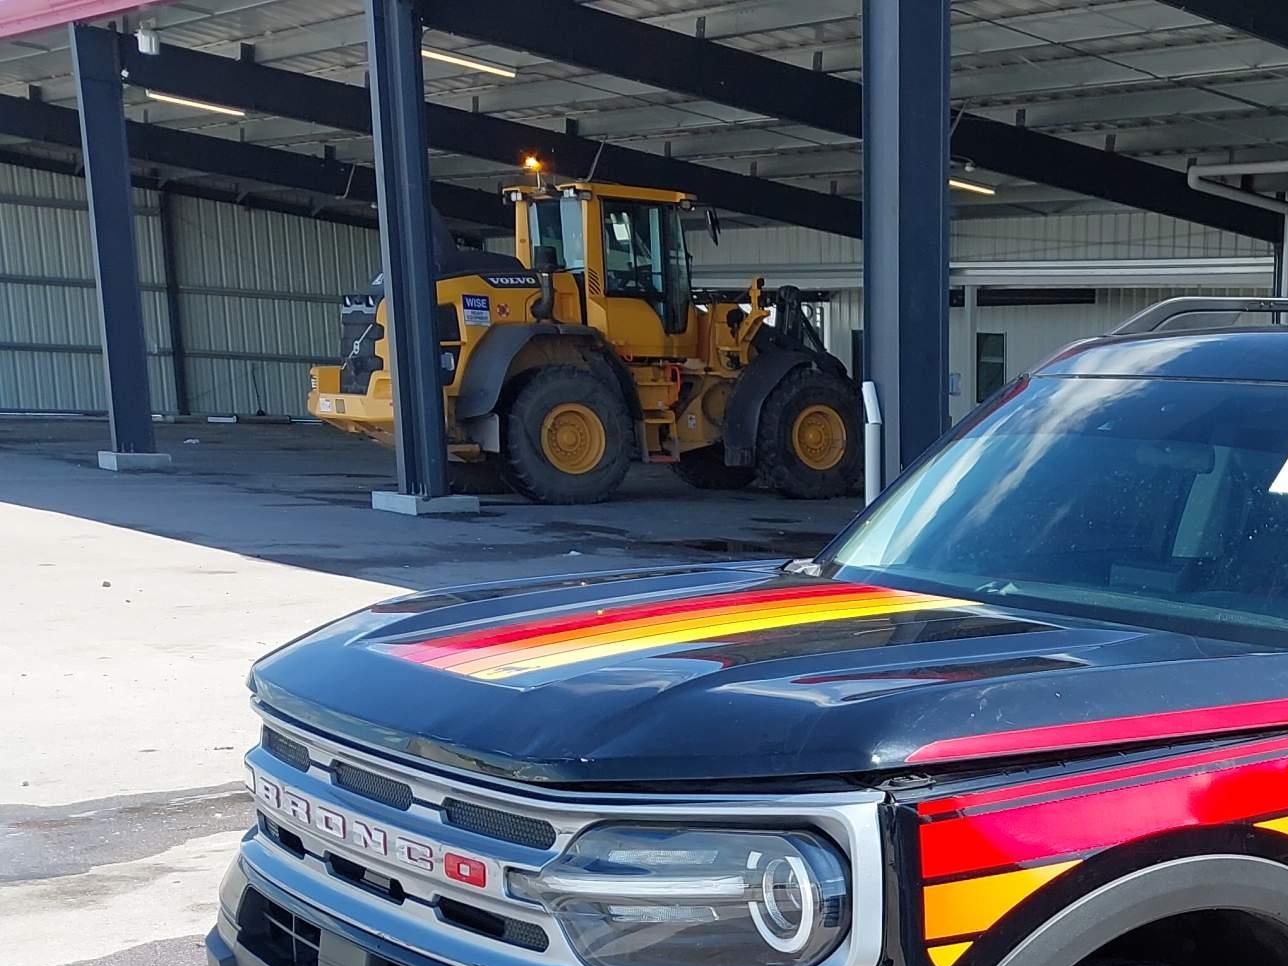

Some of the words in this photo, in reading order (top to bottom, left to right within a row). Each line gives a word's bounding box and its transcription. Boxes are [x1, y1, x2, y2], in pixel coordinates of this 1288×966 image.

[487, 277, 536, 285] VOLVO
[465, 296, 487, 309] WISE
[256, 776, 486, 889] BRONCO
